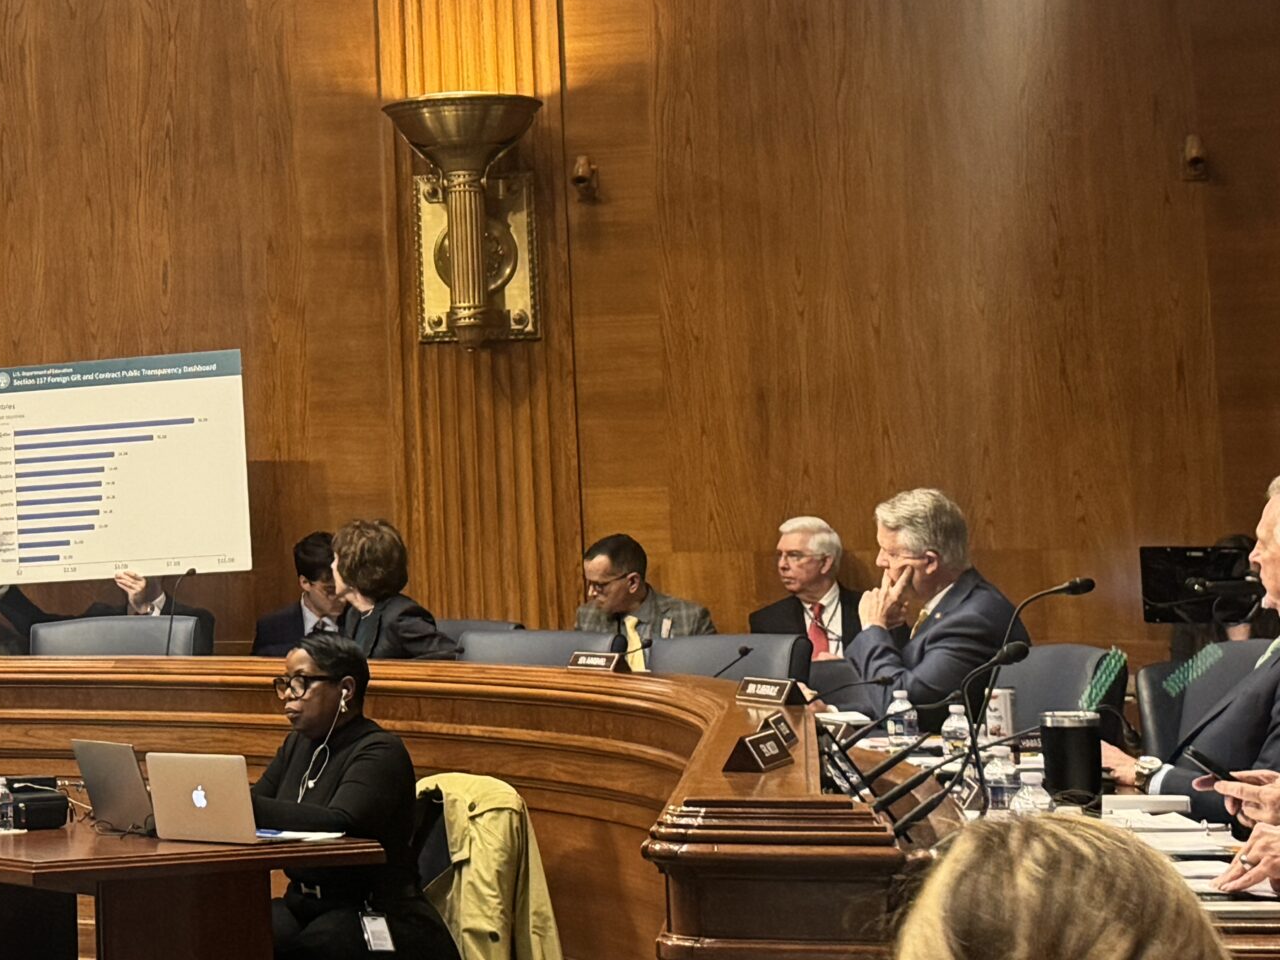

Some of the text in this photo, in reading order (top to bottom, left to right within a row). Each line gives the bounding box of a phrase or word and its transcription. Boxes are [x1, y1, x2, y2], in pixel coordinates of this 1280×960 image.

[13, 377, 36, 386] Section
[47, 375, 70, 384] Foreign
[70, 373, 82, 381] Gift
[82, 372, 94, 380] and
[94, 371, 121, 380] Contract
[121, 369, 141, 378] Public
[141, 367, 182, 377] Transparency
[183, 363, 217, 373] Dashboard
